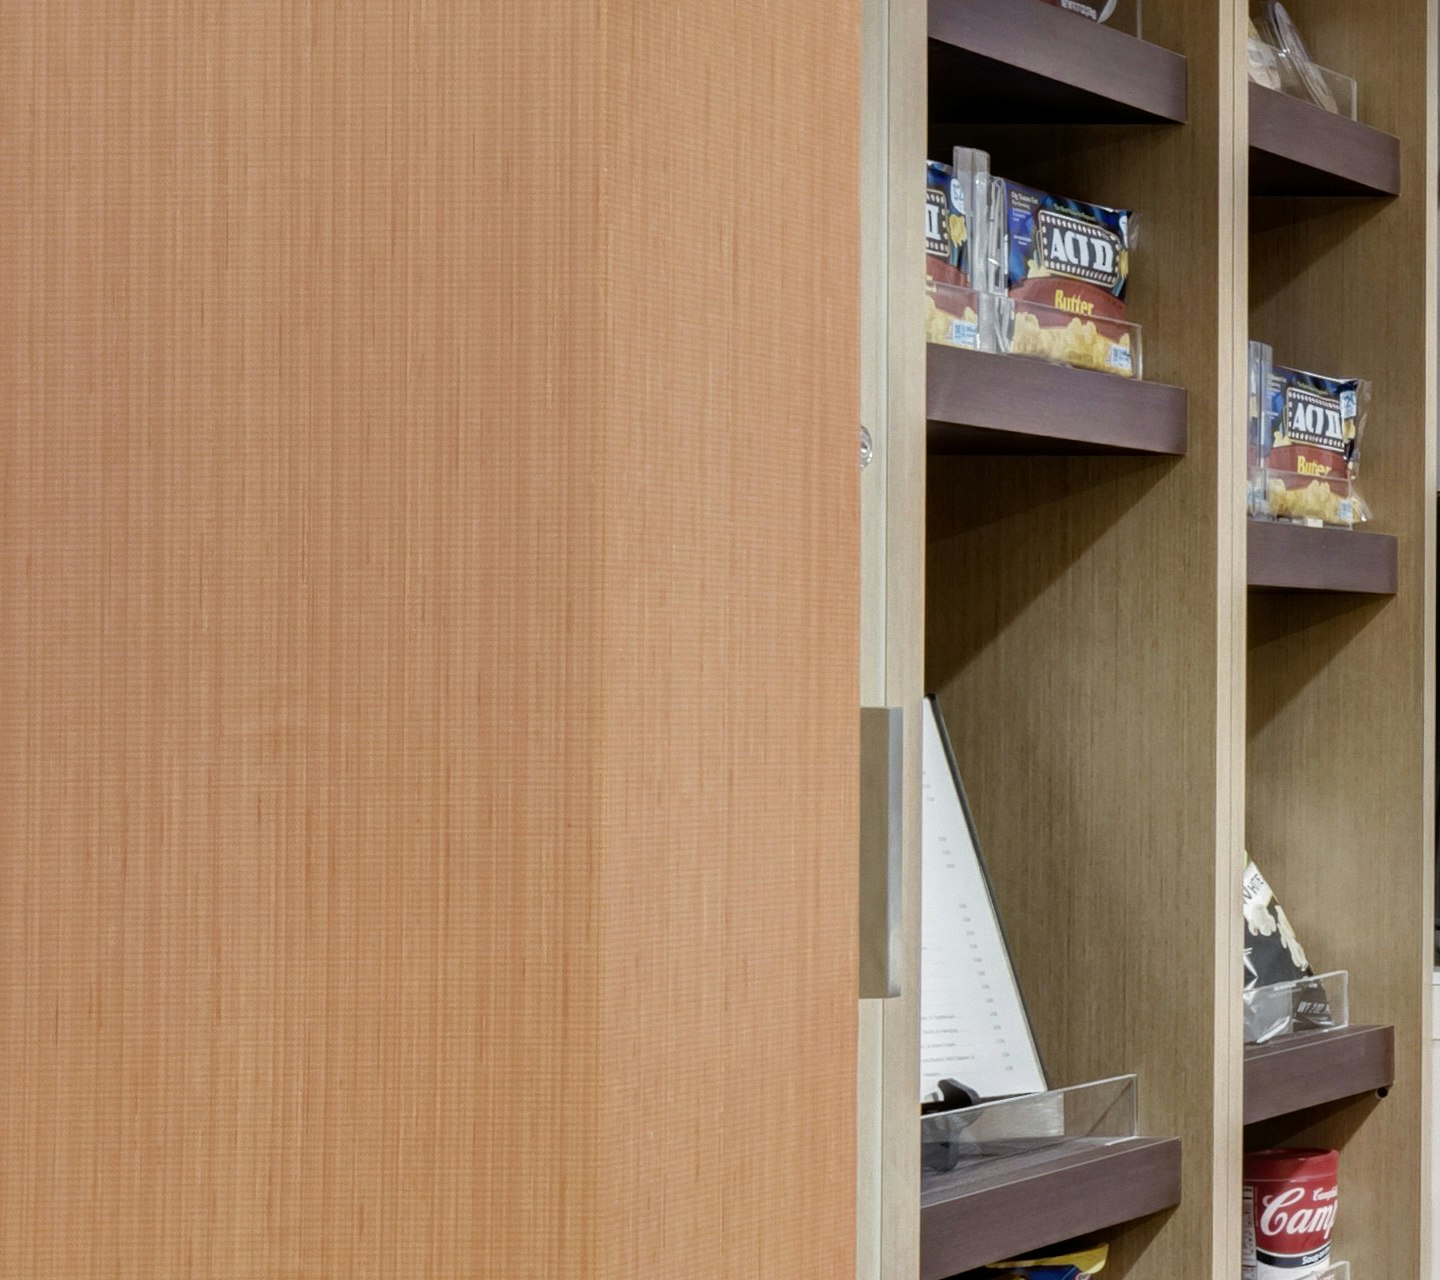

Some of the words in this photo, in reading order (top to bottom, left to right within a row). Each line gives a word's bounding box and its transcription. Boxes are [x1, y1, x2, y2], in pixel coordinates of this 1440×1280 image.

[1051, 227, 1089, 267] ACT
[1093, 237, 1114, 274] II
[1055, 289, 1094, 316] Butter
[1293, 403, 1324, 434] ACT
[1325, 410, 1342, 436] II
[1297, 455, 1332, 477] Butter
